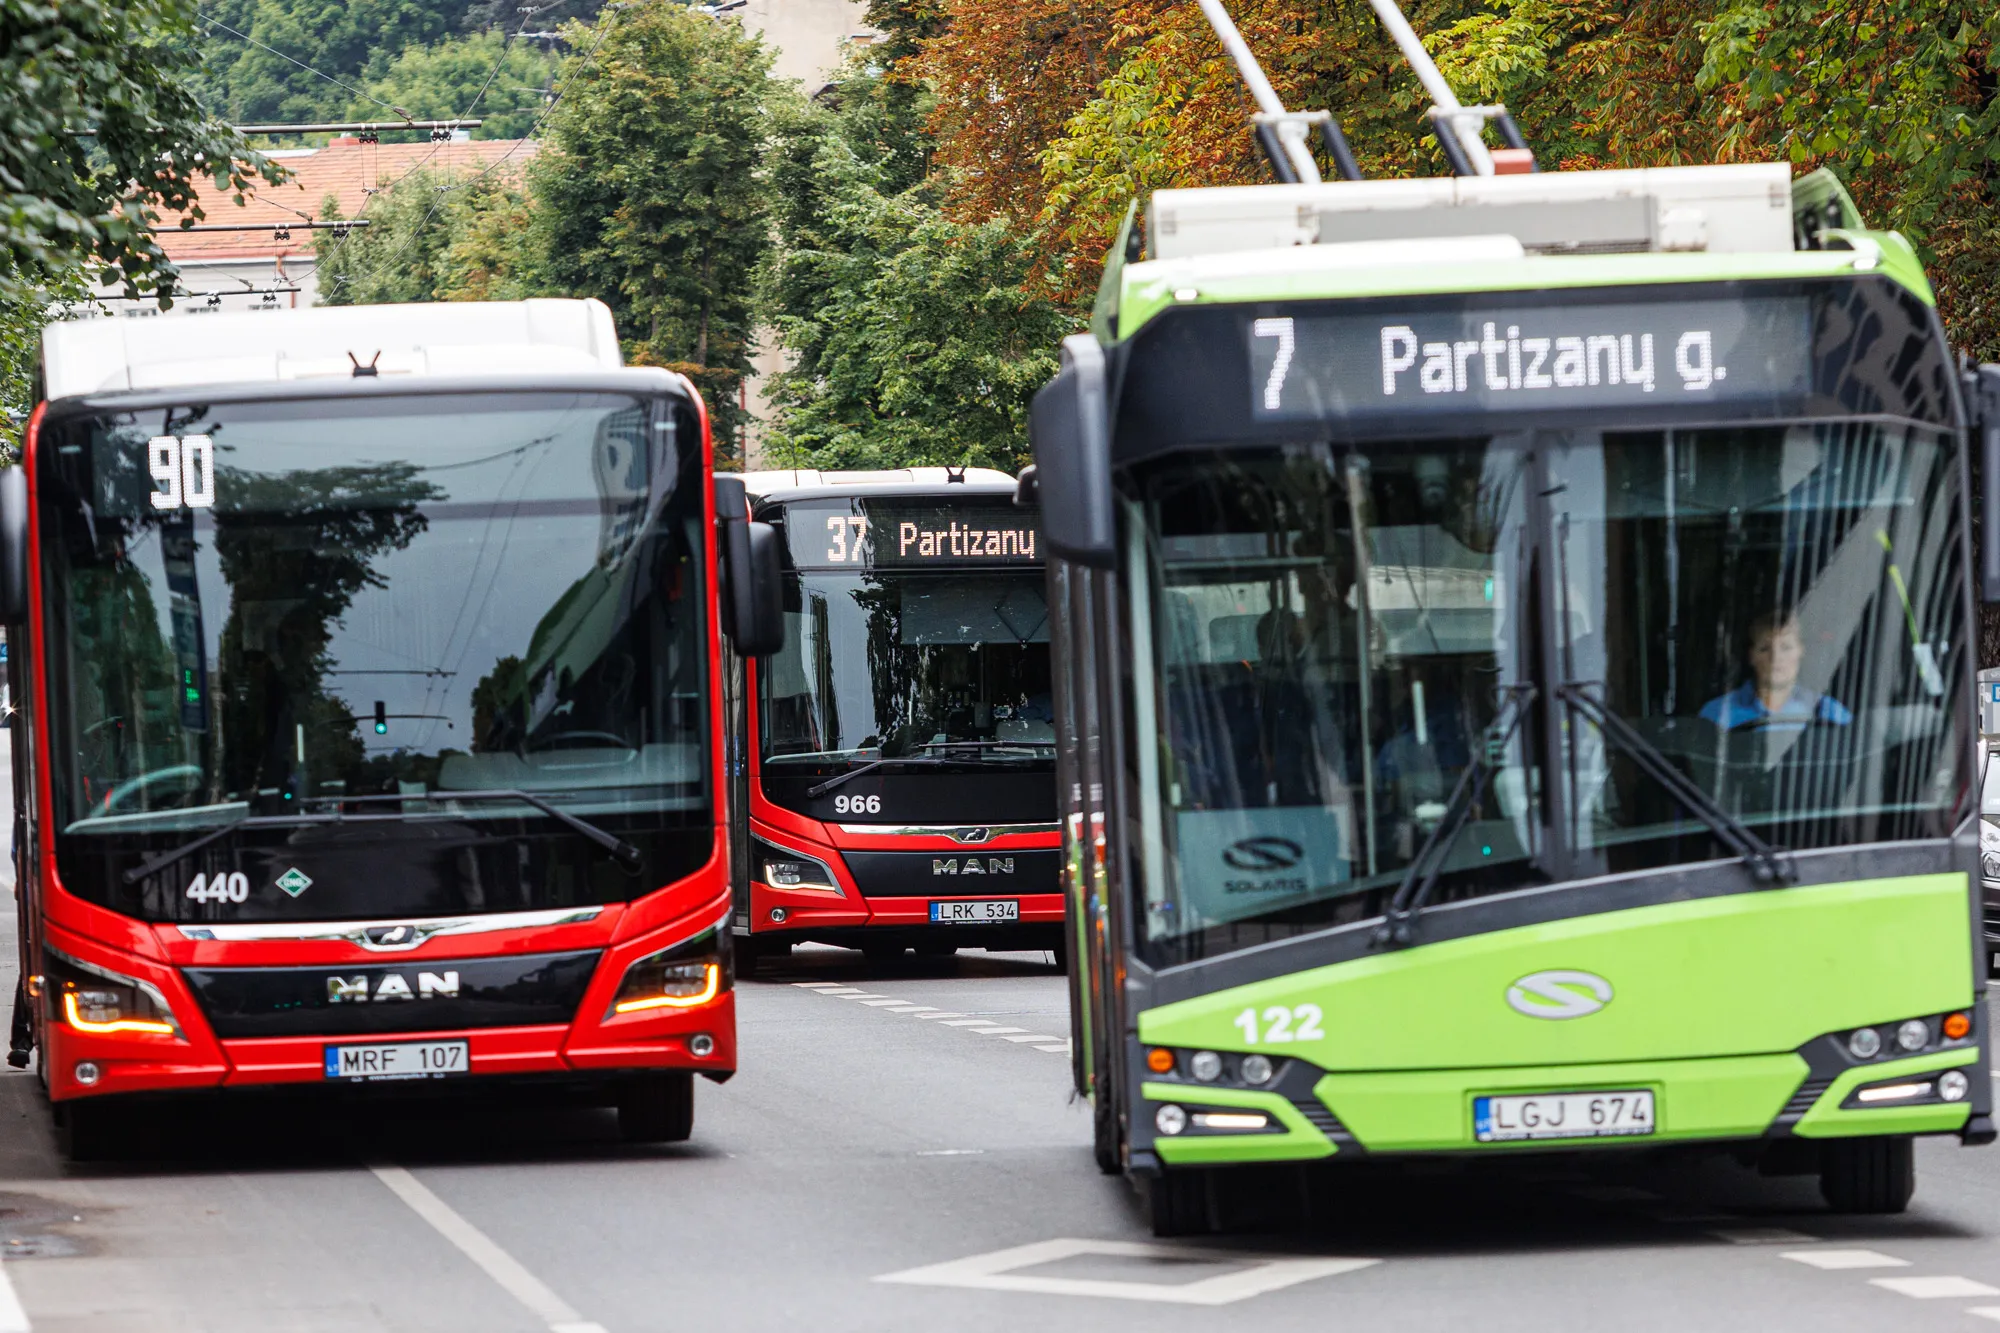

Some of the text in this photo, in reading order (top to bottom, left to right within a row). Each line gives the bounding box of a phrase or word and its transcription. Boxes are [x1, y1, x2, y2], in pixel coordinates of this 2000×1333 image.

[1254, 317, 1727, 410] 7 Partizanų g.
[148, 434, 215, 510] 90
[827, 516, 1036, 562] 37 Partizanų
[834, 794, 881, 814] 966
[932, 857, 1015, 875] MAN
[186, 872, 249, 904] 440
[941, 903, 1015, 919] LRK 534
[327, 970, 460, 1003] MAN
[1233, 1002, 1326, 1045] 122
[343, 1046, 462, 1072] MRF 107
[1496, 1101, 1566, 1129] LGJ
[1590, 1098, 1647, 1126] 674
